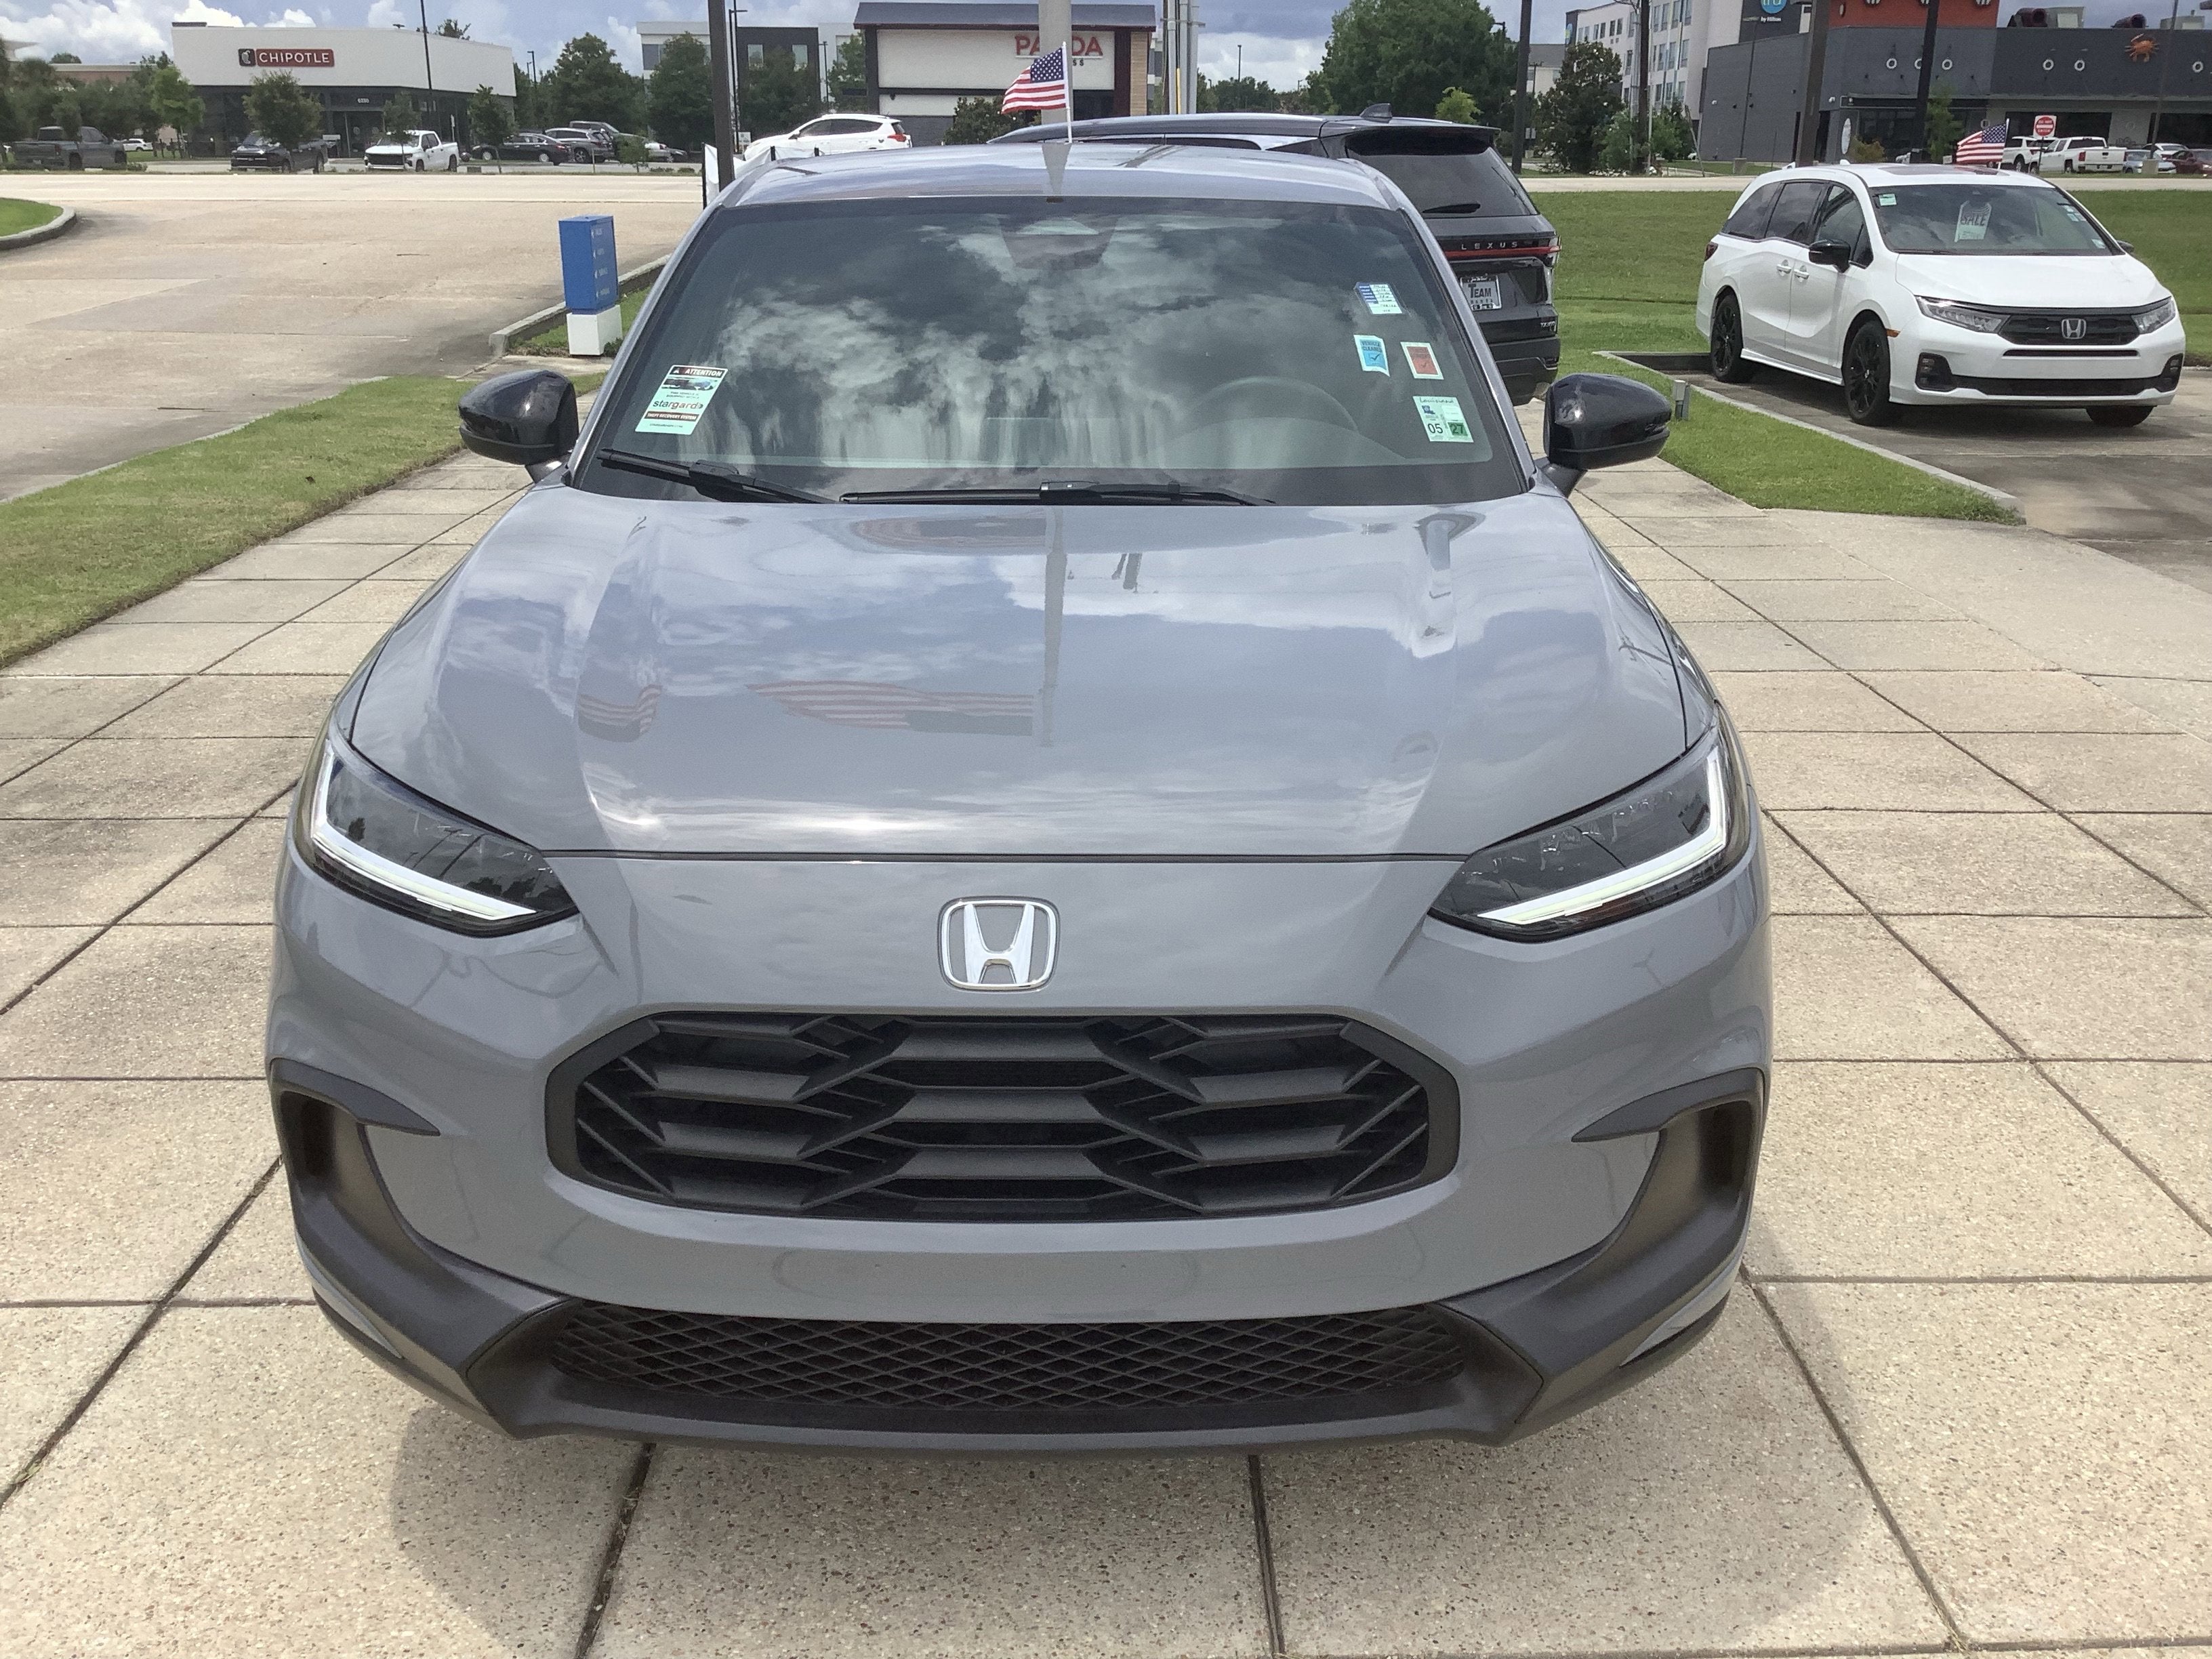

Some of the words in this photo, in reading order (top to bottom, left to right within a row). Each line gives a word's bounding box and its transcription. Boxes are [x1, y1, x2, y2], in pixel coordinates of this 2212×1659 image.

[1015, 35, 1103, 56] PADA
[259, 52, 330, 63] CHIPOTLE
[1461, 241, 1517, 250] LEXUS
[684, 368, 722, 377] ATTENTION
[653, 400, 698, 410] stargard
[1427, 423, 1443, 434] 05
[1450, 424, 1464, 434] 27
